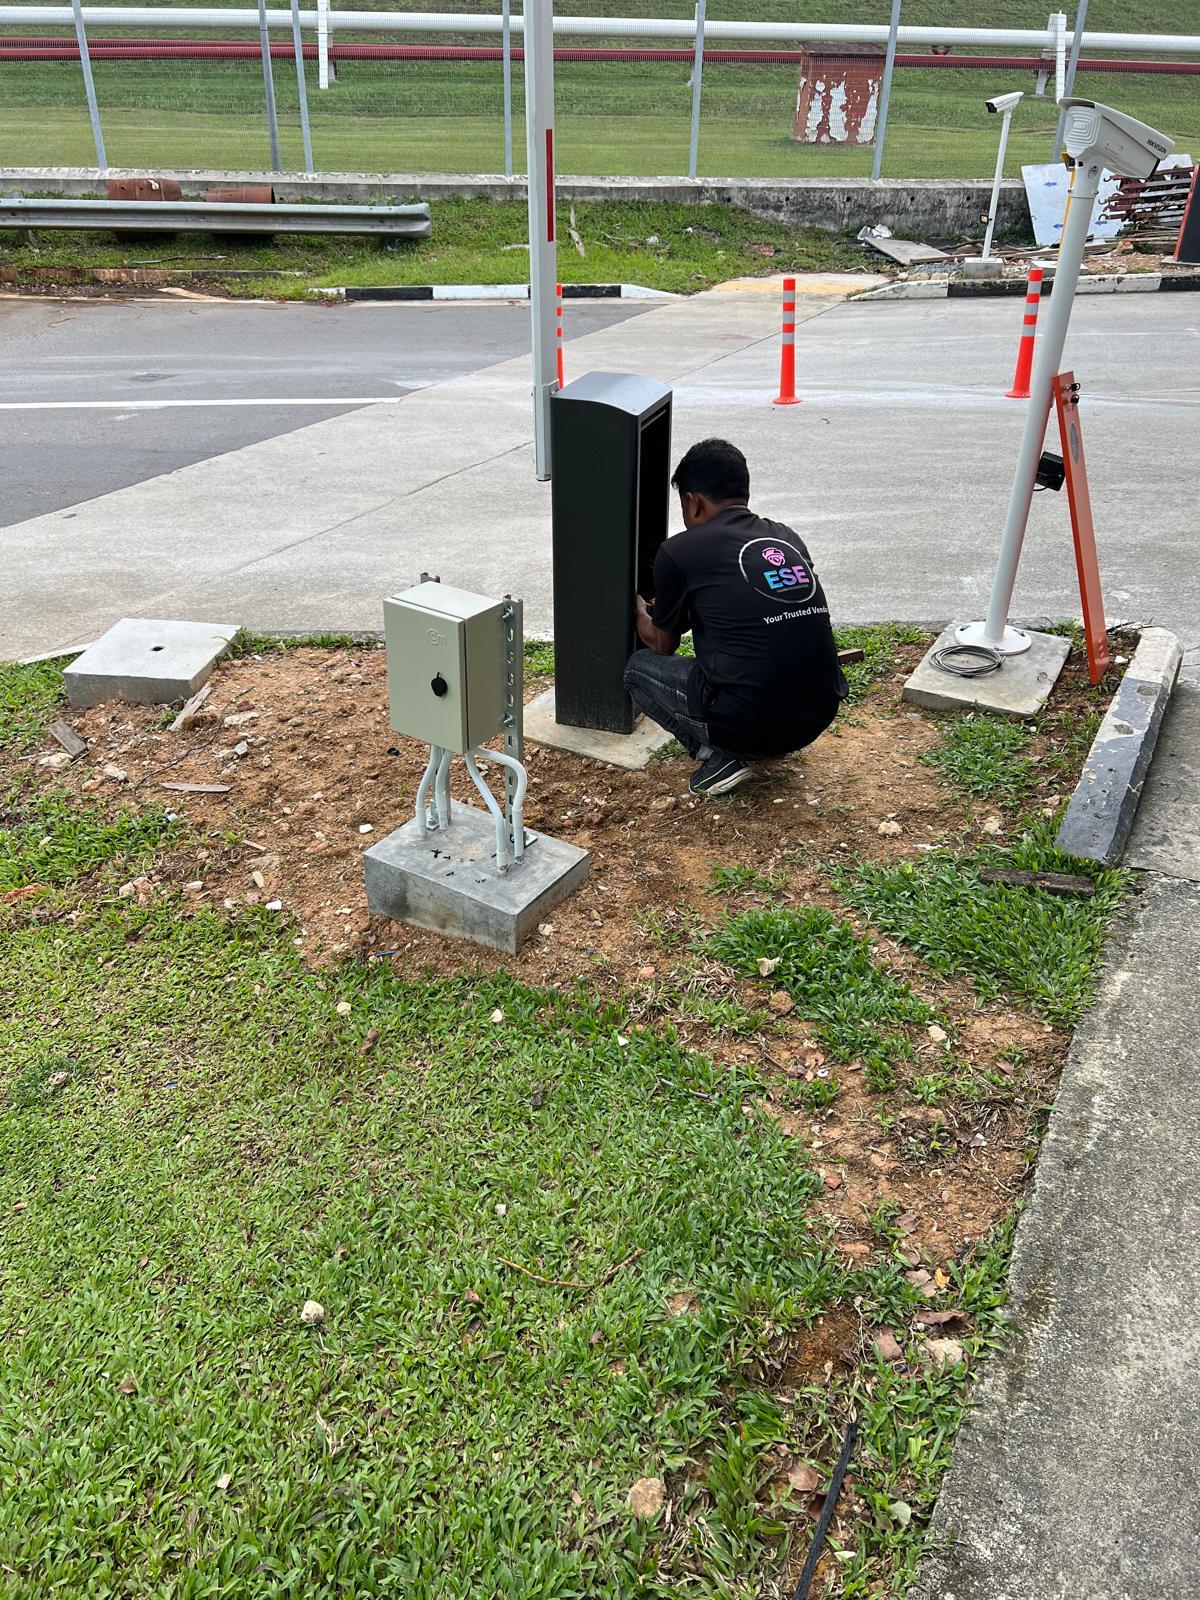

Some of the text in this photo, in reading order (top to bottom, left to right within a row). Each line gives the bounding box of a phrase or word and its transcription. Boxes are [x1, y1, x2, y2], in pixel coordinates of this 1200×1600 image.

[1147, 138, 1167, 154] HIKVISION
[763, 565, 810, 590] ESE
[763, 614, 783, 624] Your
[783, 606, 811, 620] Trusted
